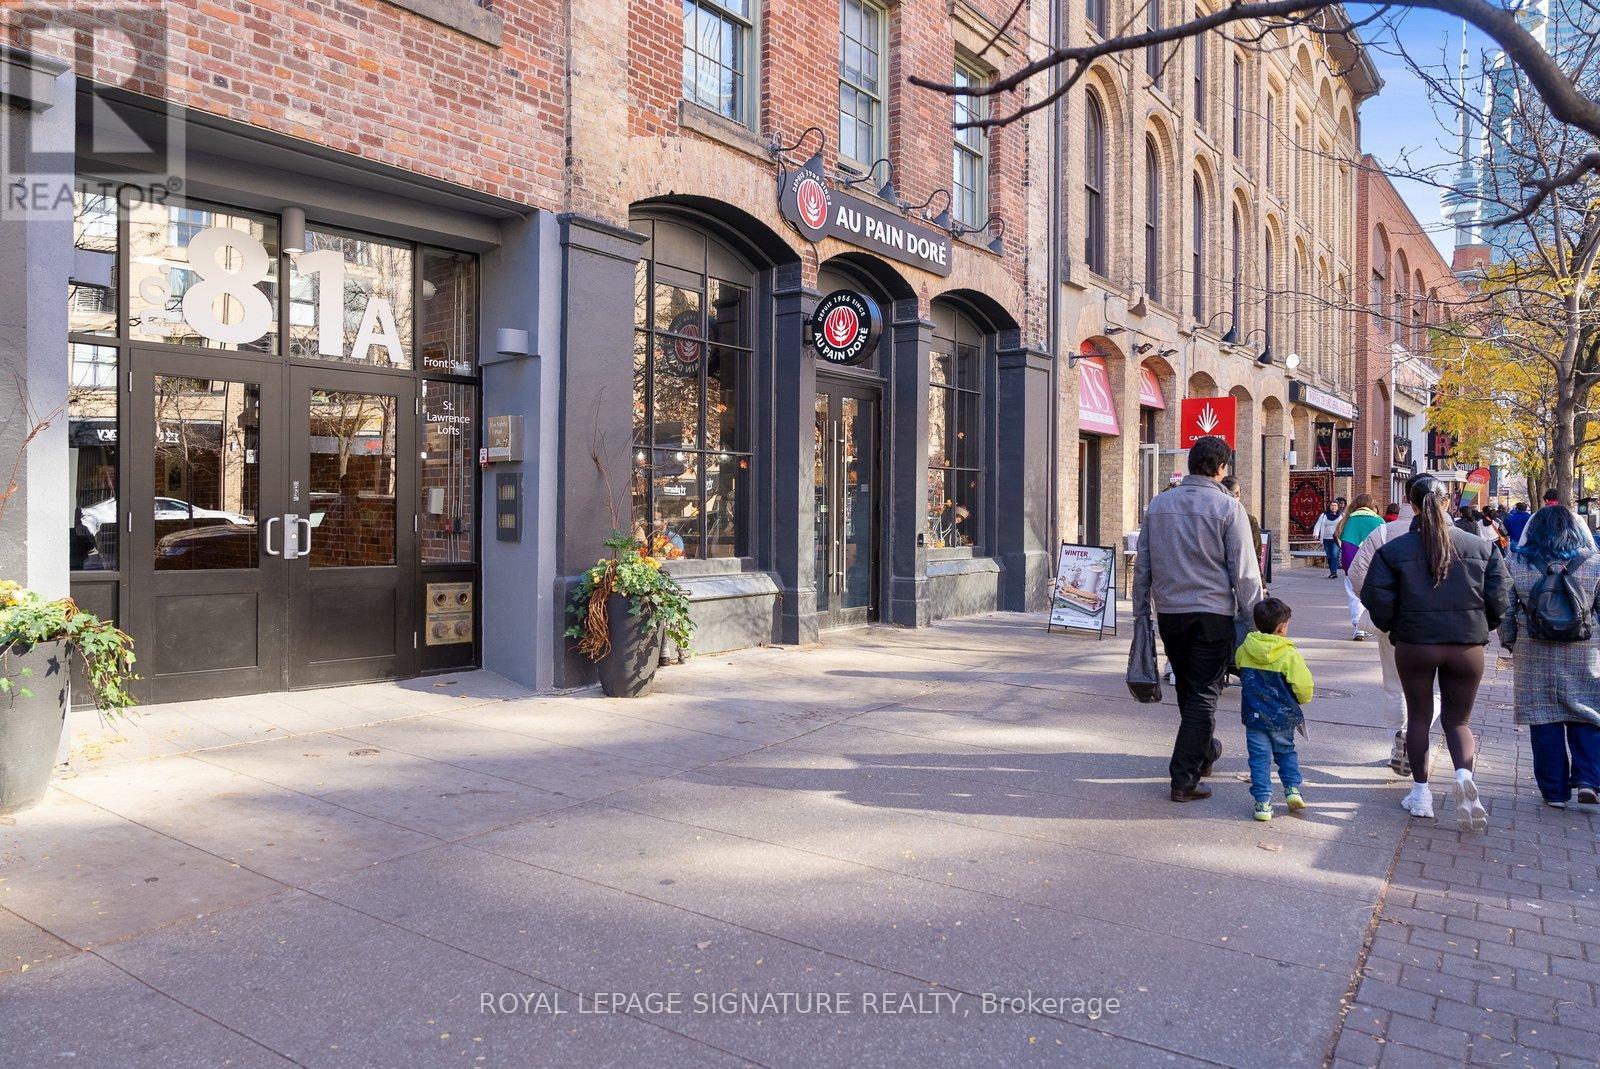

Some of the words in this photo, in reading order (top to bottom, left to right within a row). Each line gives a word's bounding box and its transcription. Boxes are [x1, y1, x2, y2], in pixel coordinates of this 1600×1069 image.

[835, 206, 861, 233] AU
[865, 215, 903, 250] PAIN
[907, 232, 947, 266] DORÉ
[817, 301, 833, 322] DEPUIS
[833, 295, 850, 303] 1956
[851, 299, 866, 317] SINCE
[814, 332, 825, 348] AU
[822, 345, 845, 360] PAIN
[846, 327, 869, 357] DORÉ
[423, 356, 448, 369] Front
[450, 359, 461, 370] St.
[463, 362, 471, 371] E.
[443, 400, 454, 411] St.
[426, 411, 470, 424] Lawrence
[437, 424, 460, 436] Lofts
[1064, 549, 1089, 557] WINTER
